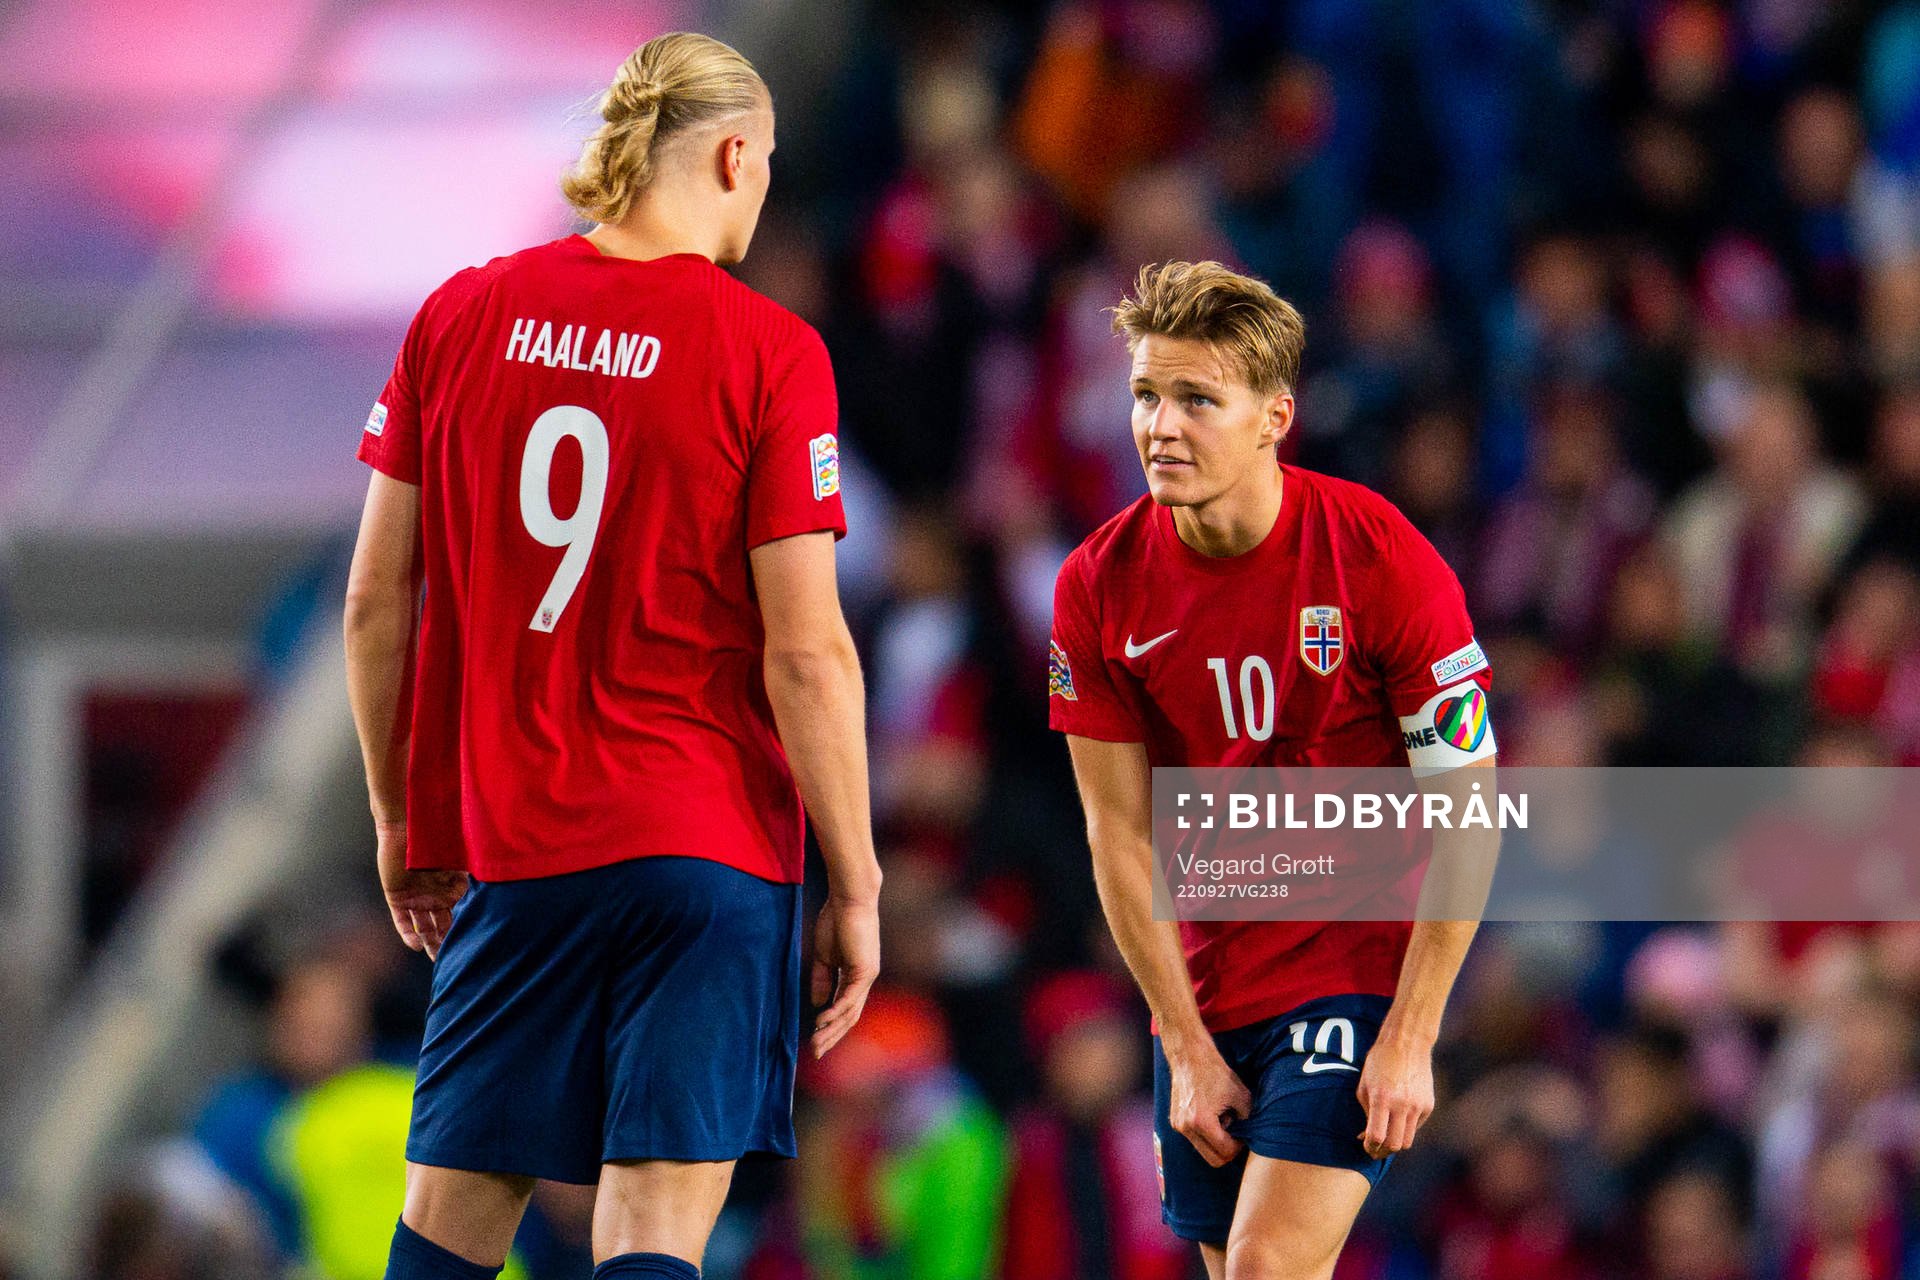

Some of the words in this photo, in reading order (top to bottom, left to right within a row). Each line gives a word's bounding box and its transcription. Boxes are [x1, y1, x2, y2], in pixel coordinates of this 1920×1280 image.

[505, 318, 661, 379] HAALAND
[519, 405, 609, 633] 9
[1207, 655, 1275, 742] 10
[1290, 1018, 1354, 1063] 10
